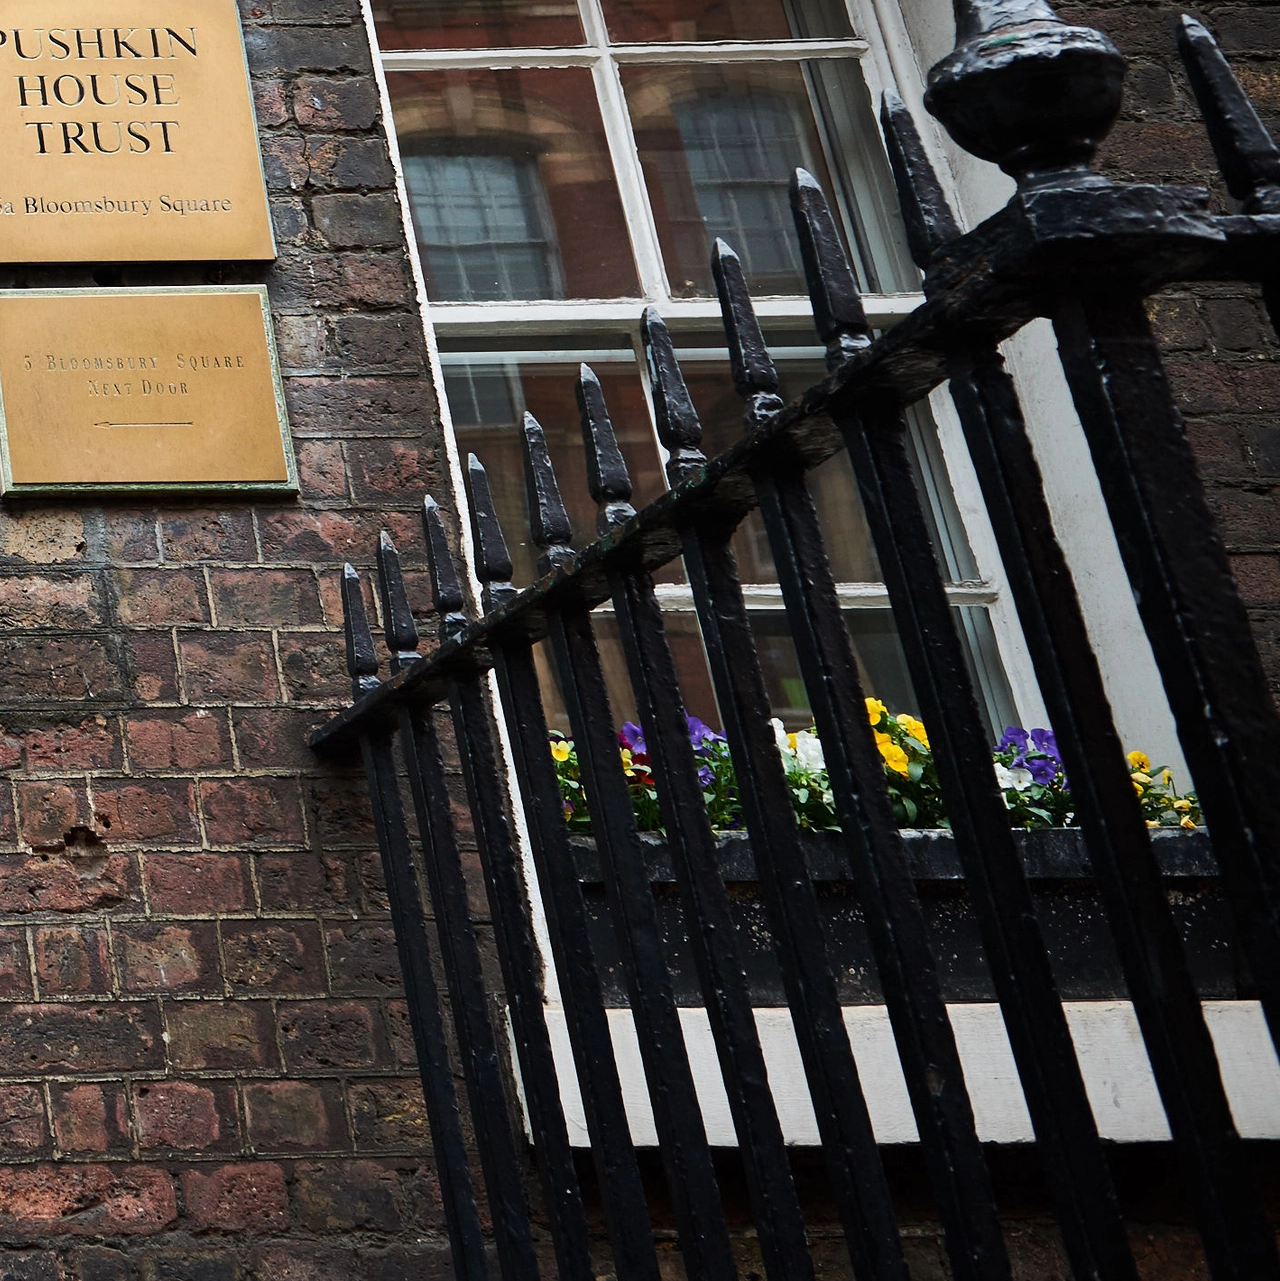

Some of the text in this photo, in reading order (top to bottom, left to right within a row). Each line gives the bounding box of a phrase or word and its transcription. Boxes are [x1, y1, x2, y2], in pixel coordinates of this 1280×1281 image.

[14, 73, 181, 107] HOUSE
[24, 120, 180, 155] TRUST
[23, 194, 152, 217] Bloomsbury
[159, 194, 232, 217] Square
[23, 352, 245, 373] 5 BLOOMSBURY SQUARE
[88, 379, 189, 397] NEXT DOOR
